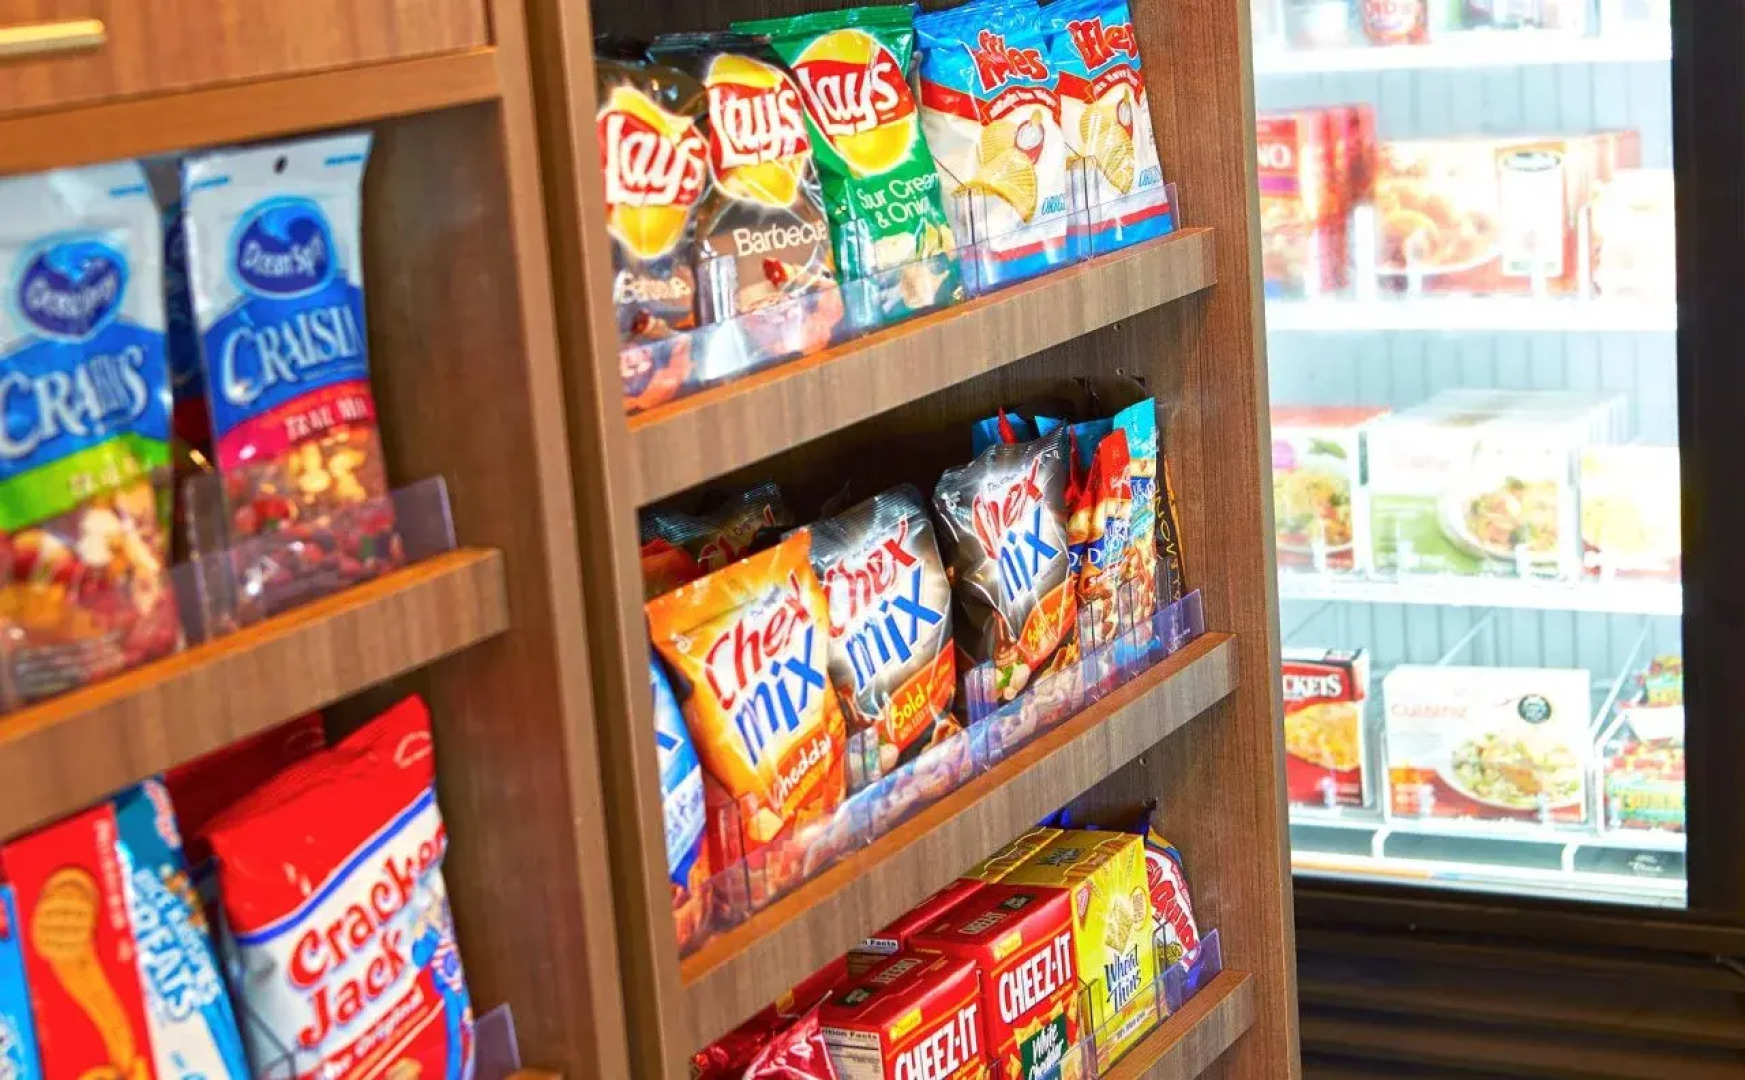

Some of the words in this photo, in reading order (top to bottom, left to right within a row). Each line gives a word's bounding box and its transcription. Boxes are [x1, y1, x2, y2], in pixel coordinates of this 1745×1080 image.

[874, 210, 892, 229] &
[704, 568, 811, 710] Chex
[823, 518, 917, 639] Chex
[844, 564, 944, 692] mix
[734, 623, 826, 766] mix
[296, 924, 406, 1047] Jack
[998, 932, 1072, 1024] CHEEZ-IT
[1104, 943, 1139, 992] Wheat
[895, 1003, 978, 1080] CHEEZ-IT
